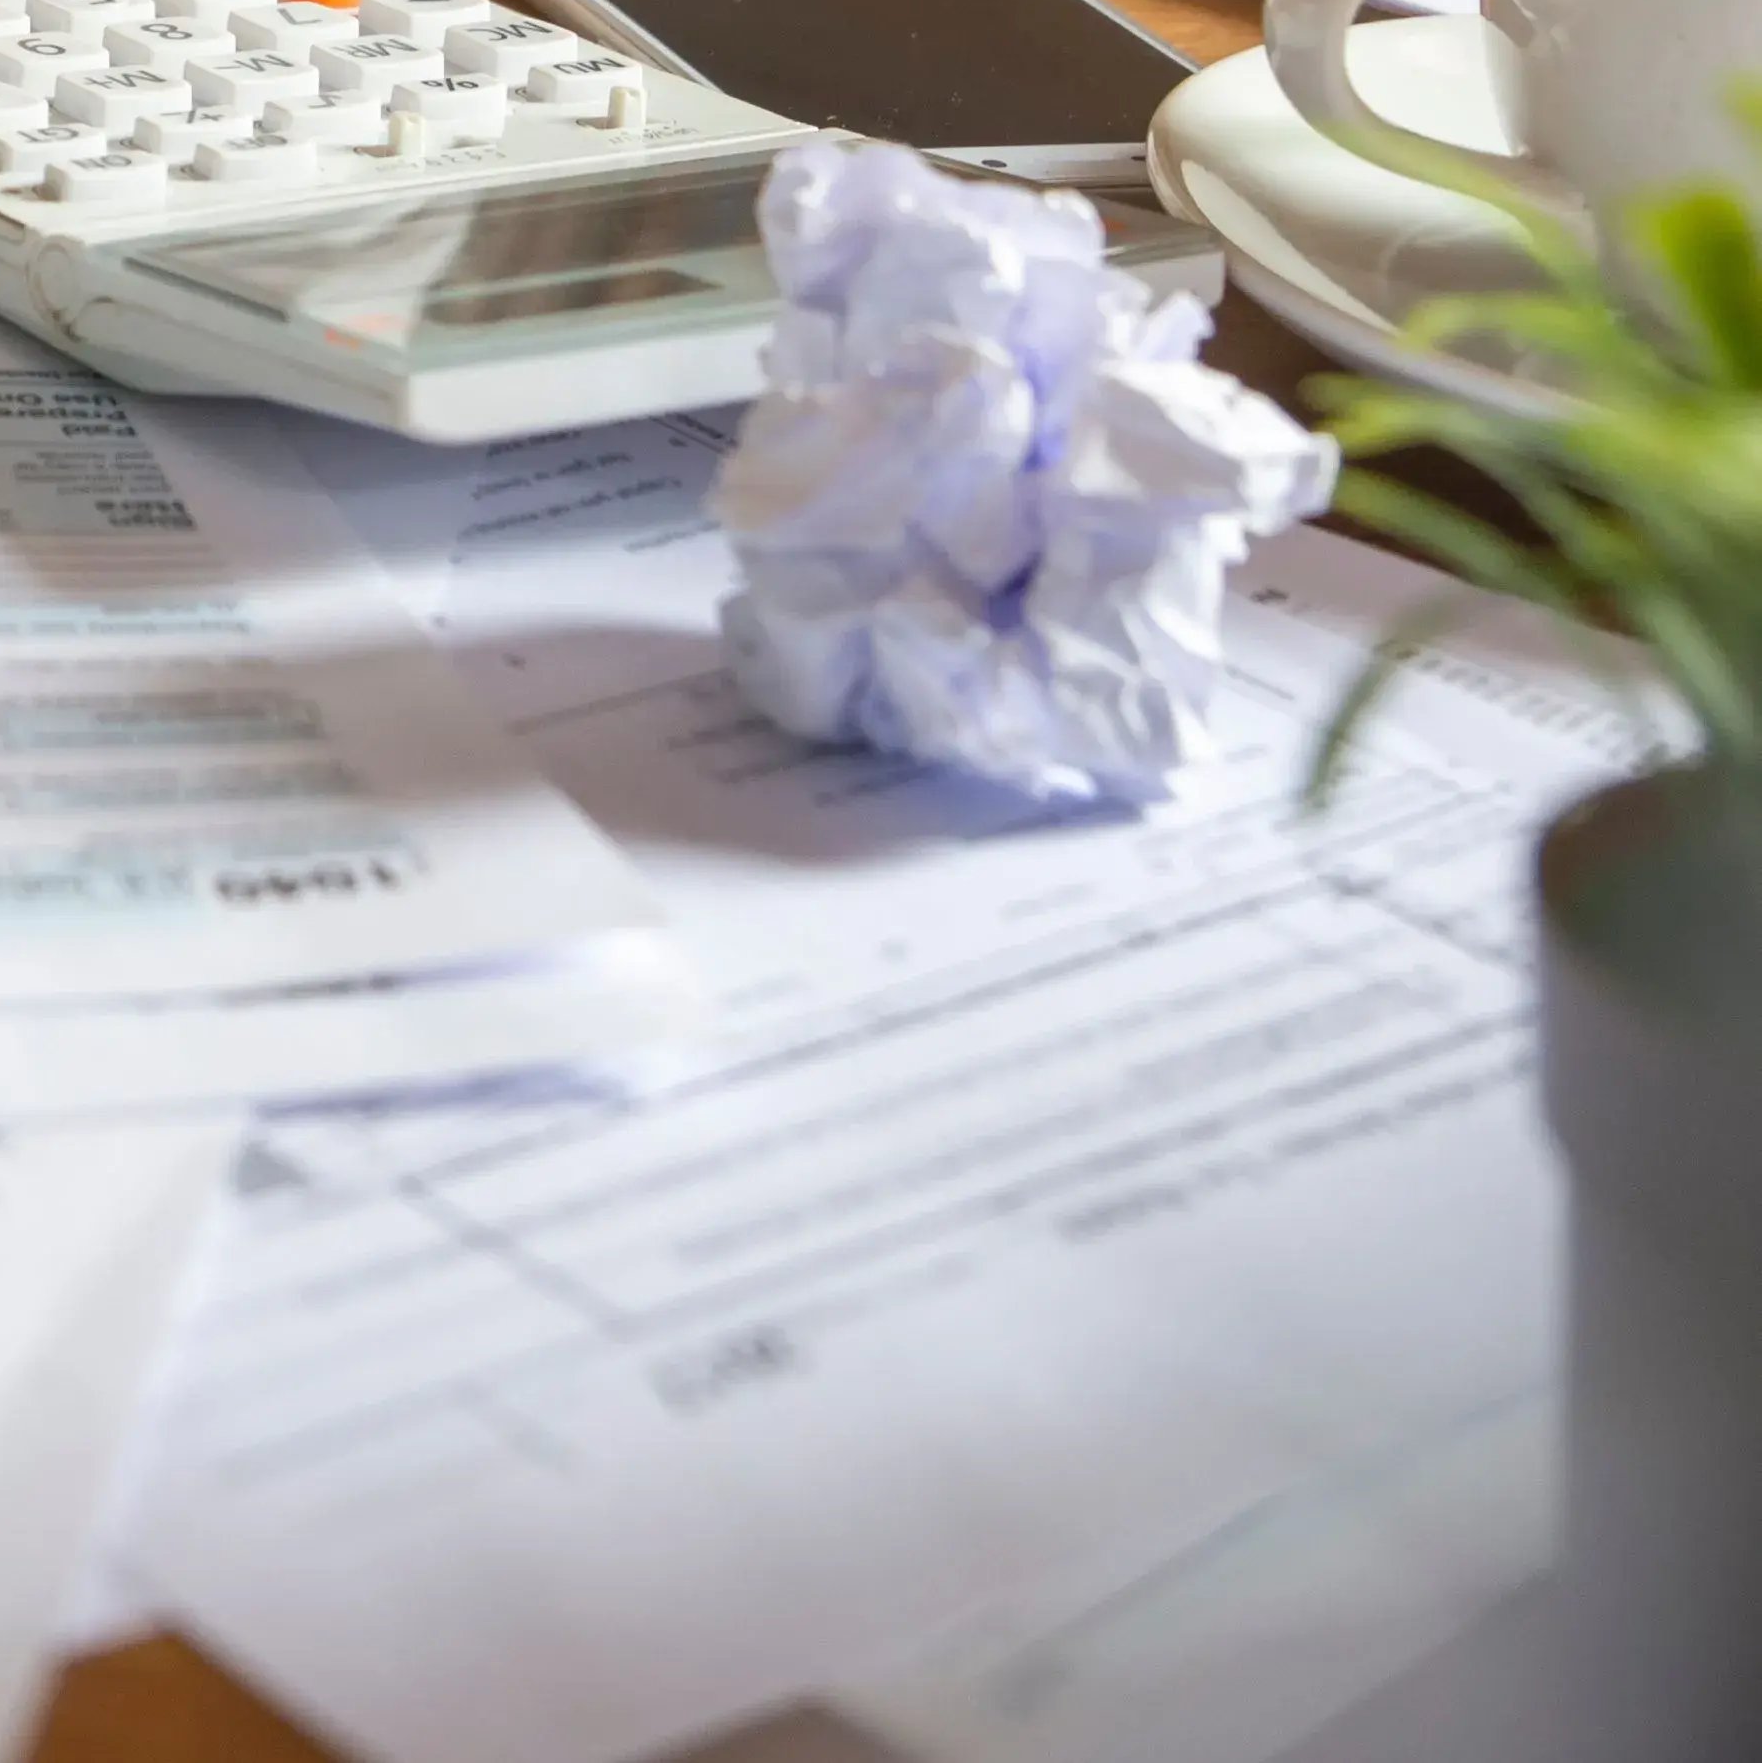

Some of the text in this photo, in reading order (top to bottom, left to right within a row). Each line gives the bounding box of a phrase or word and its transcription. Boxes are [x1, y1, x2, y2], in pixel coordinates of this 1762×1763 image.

[275, 7, 324, 26] 7
[140, 22, 193, 41] 8
[468, 20, 554, 42] MC
[16, 38, 67, 56] 9
[331, 38, 420, 58] MR
[559, 57, 626, 75] MU
[84, 70, 167, 89] M+
[421, 76, 479, 93] %
[15, 125, 81, 144] GT
[73, 153, 133, 171] ON
[52, 393, 117, 407] Use
[60, 423, 138, 439] Paid
